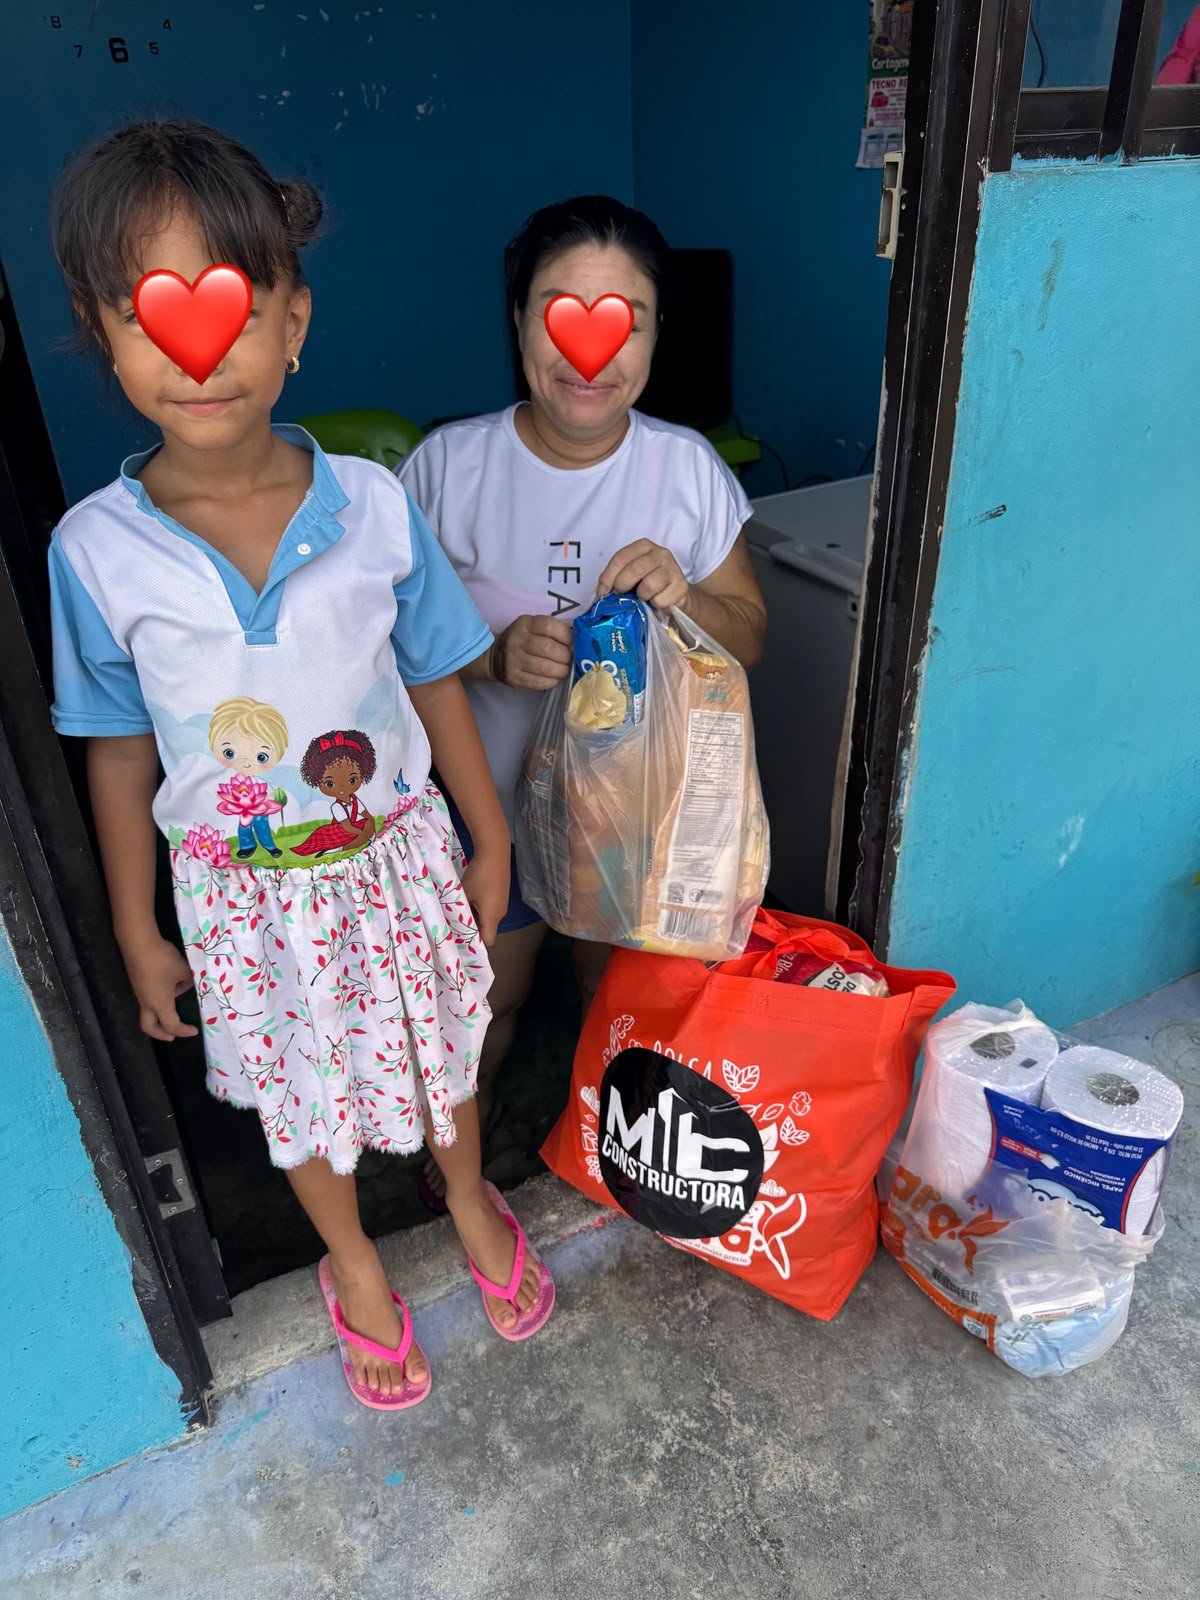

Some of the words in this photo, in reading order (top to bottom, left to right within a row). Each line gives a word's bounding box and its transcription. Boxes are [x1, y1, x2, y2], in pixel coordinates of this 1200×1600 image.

[51, 15, 62, 29] 8
[162, 18, 172, 31] 4
[73, 44, 83, 58] 7
[108, 36, 129, 64] 6
[148, 41, 160, 55] 5
[871, 79, 897, 89] TECNO
[601, 1133, 746, 1211] CONSTRUCTORA
[1101, 1183, 1123, 1193] PAPEL
